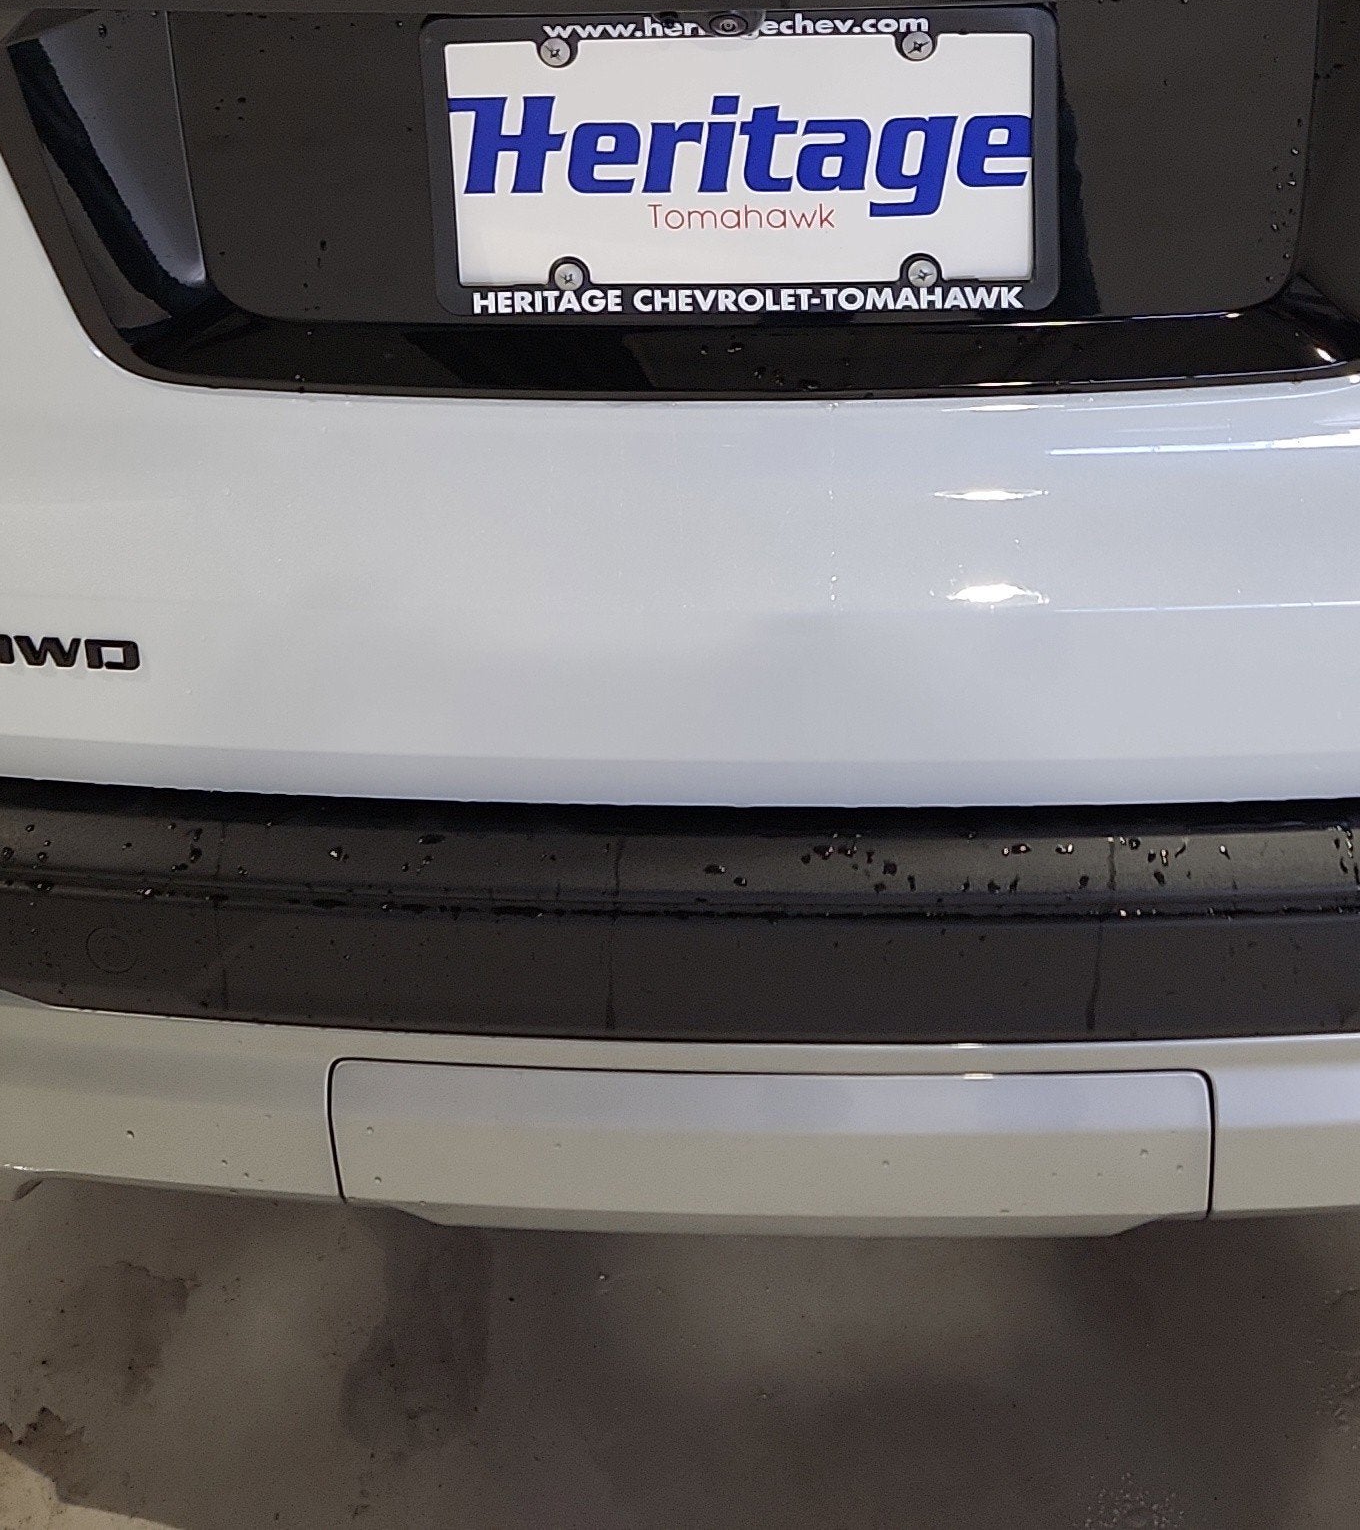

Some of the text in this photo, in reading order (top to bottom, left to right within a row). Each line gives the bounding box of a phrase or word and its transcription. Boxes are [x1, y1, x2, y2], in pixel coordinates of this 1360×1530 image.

[447, 94, 1032, 218] Heritage
[647, 203, 836, 230] Tomahawk
[472, 285, 1024, 315] HERITAGE CHEVROLET-TOMAHAWK
